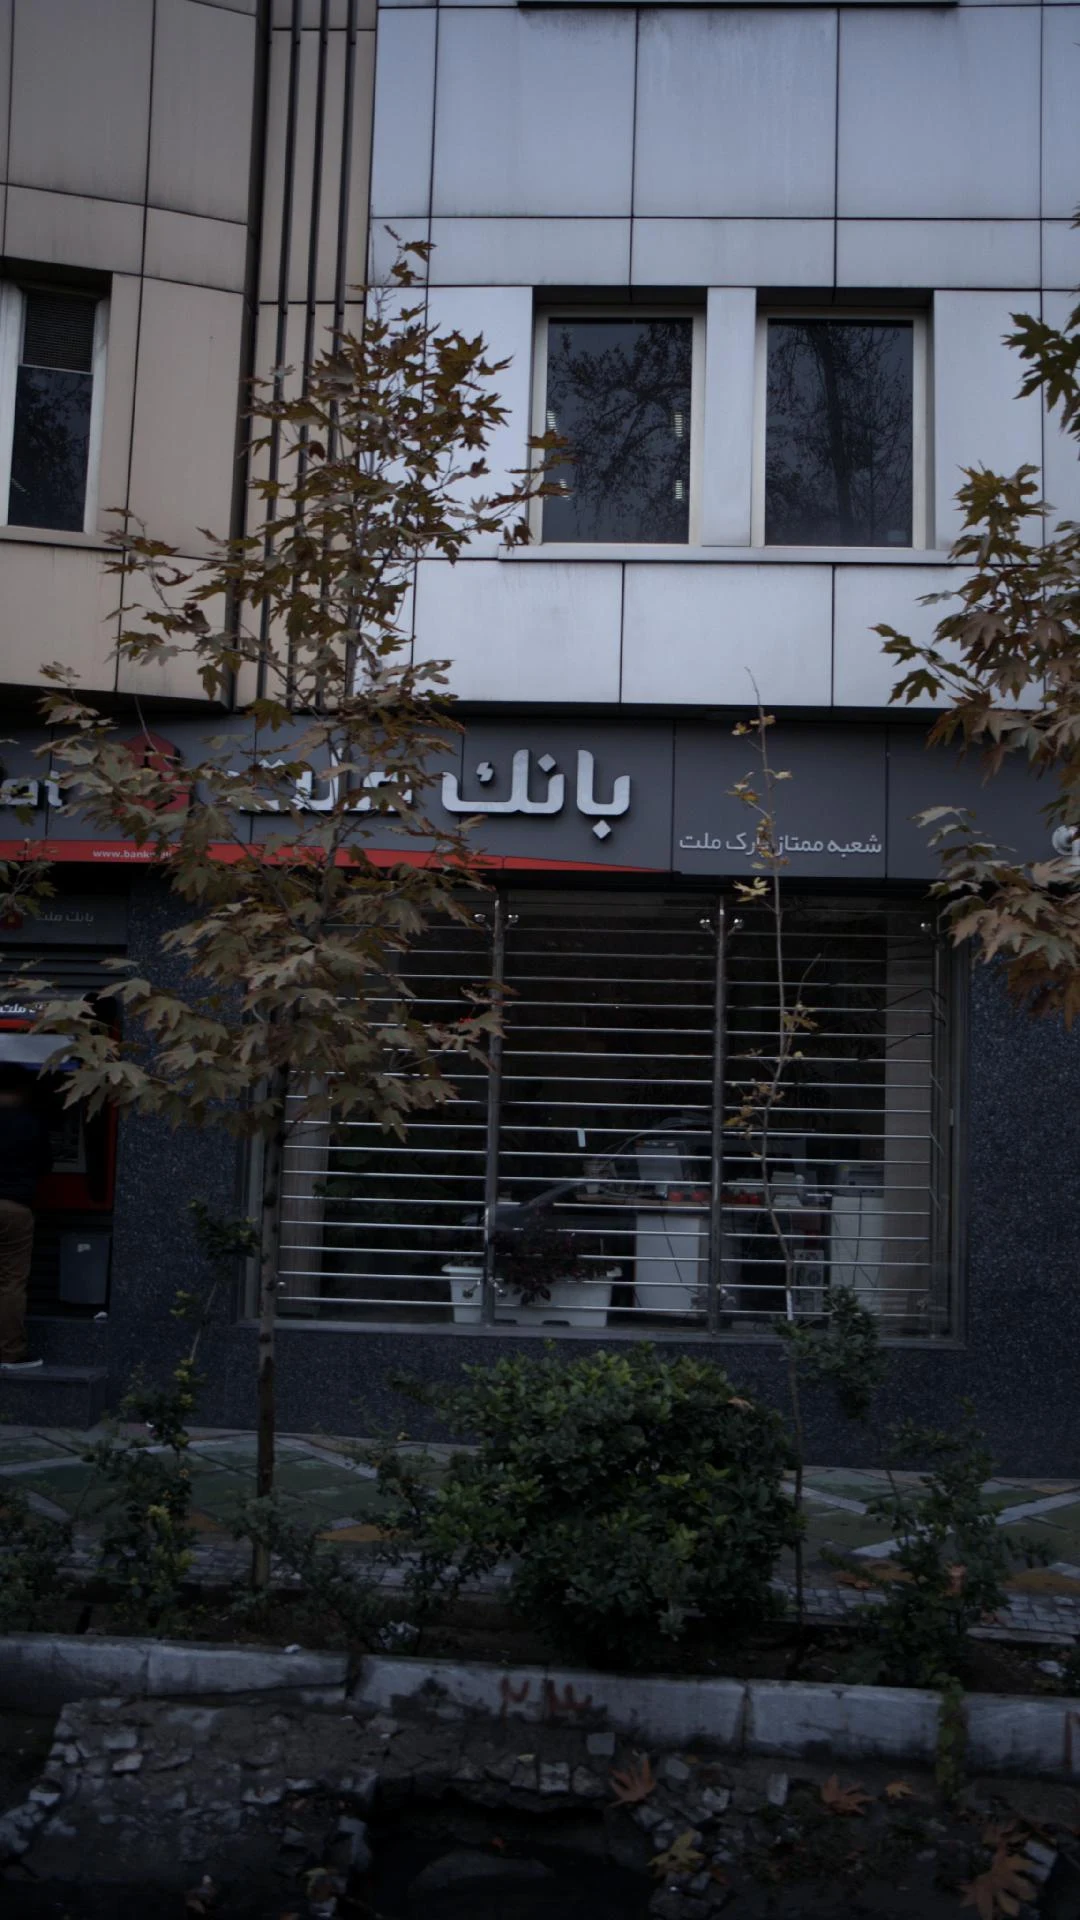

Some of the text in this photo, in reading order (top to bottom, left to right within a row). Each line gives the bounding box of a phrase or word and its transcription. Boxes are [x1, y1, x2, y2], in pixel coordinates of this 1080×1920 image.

[679, 831, 882, 858] شعبه ممتاز ارک ملت
